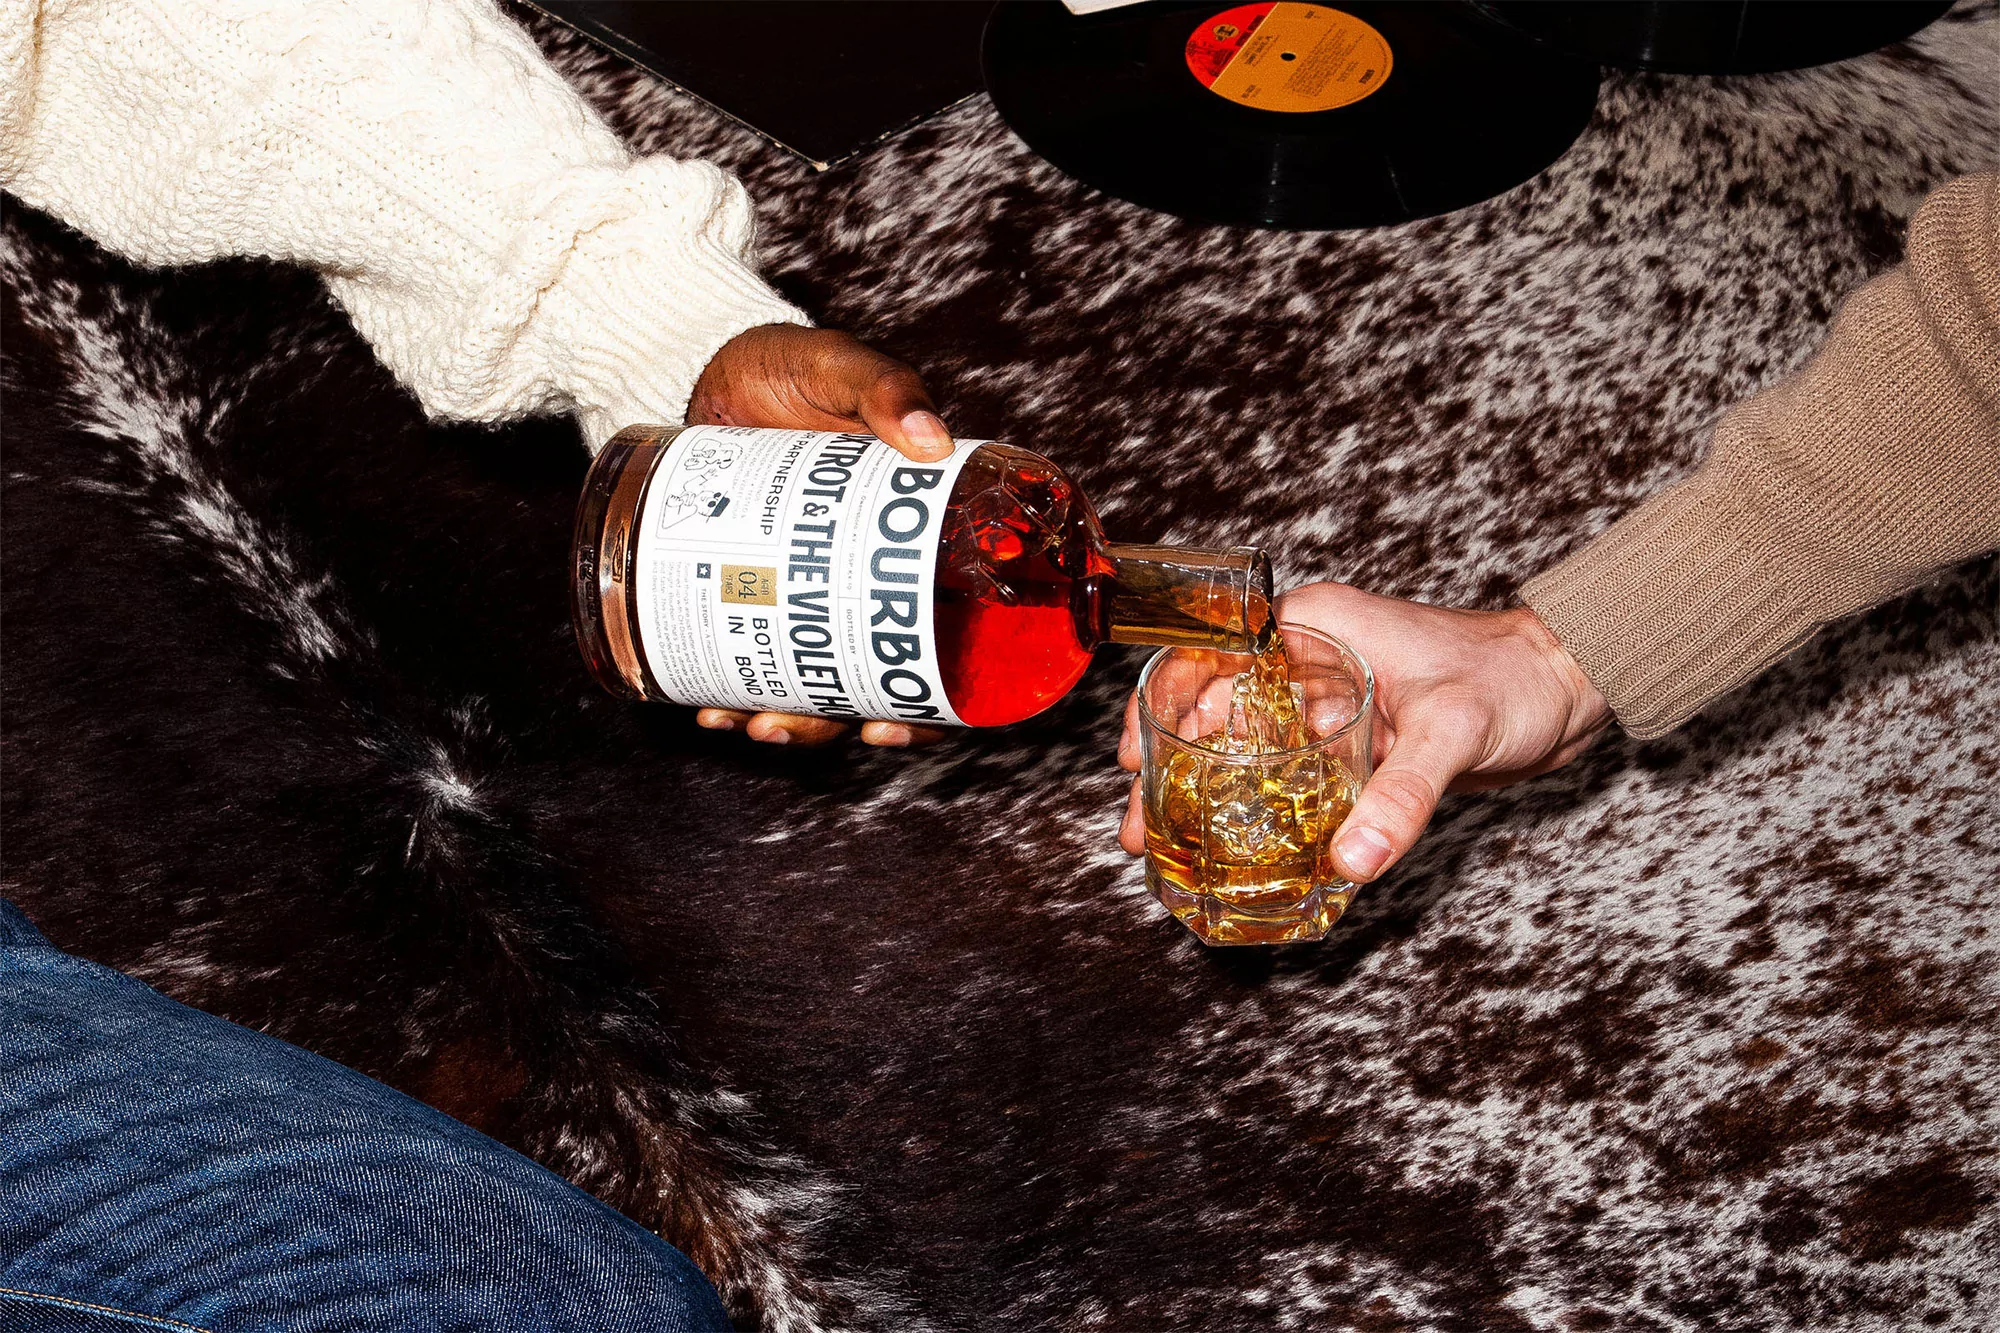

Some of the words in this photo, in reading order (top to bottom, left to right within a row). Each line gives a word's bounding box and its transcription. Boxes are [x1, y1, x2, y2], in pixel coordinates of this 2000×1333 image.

[760, 440, 809, 535] PARTNERSHIP
[802, 502, 830, 517] &
[788, 520, 837, 583] THE
[737, 571, 758, 599] 04
[870, 466, 948, 721] BOURBON
[701, 604, 709, 627] STORY
[728, 616, 745, 635] IN
[787, 590, 846, 693] VIOLET
[734, 655, 764, 696] BOND
[752, 617, 788, 697] BOTTLED
